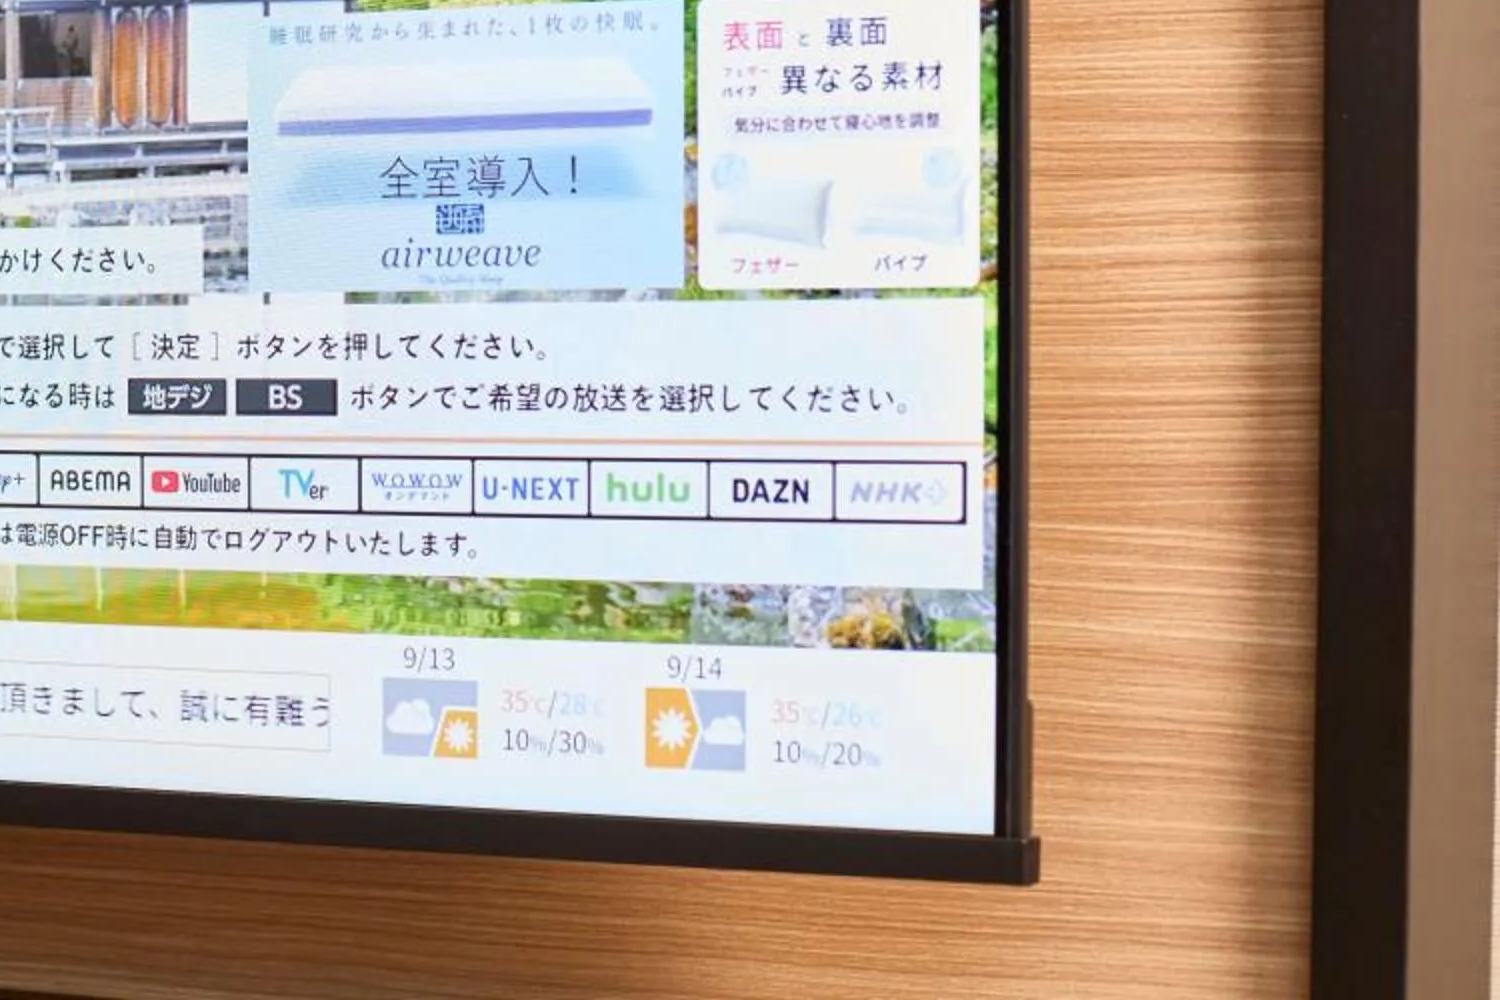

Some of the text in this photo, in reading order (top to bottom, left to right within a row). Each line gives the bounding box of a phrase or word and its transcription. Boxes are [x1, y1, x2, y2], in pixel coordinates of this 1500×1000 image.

[780, 60, 943, 96] 異なる素材
[379, 154, 578, 198] 全室導入！
[381, 237, 541, 269] airweave
[732, 256, 799, 274] フェザー
[143, 385, 212, 410] 地デジ
[269, 386, 302, 409] BS
[351, 384, 907, 414] ボタンでご希望の放送を選択してください。
[51, 469, 131, 491] ABEMA
[184, 474, 240, 493] YouTube
[279, 469, 328, 500] TVer
[483, 477, 579, 501] U-NEXT
[607, 473, 690, 503] hulu
[732, 478, 810, 504] DAZN
[850, 480, 923, 503] NHK
[403, 647, 455, 672] 9/13
[668, 656, 722, 681] 9/14
